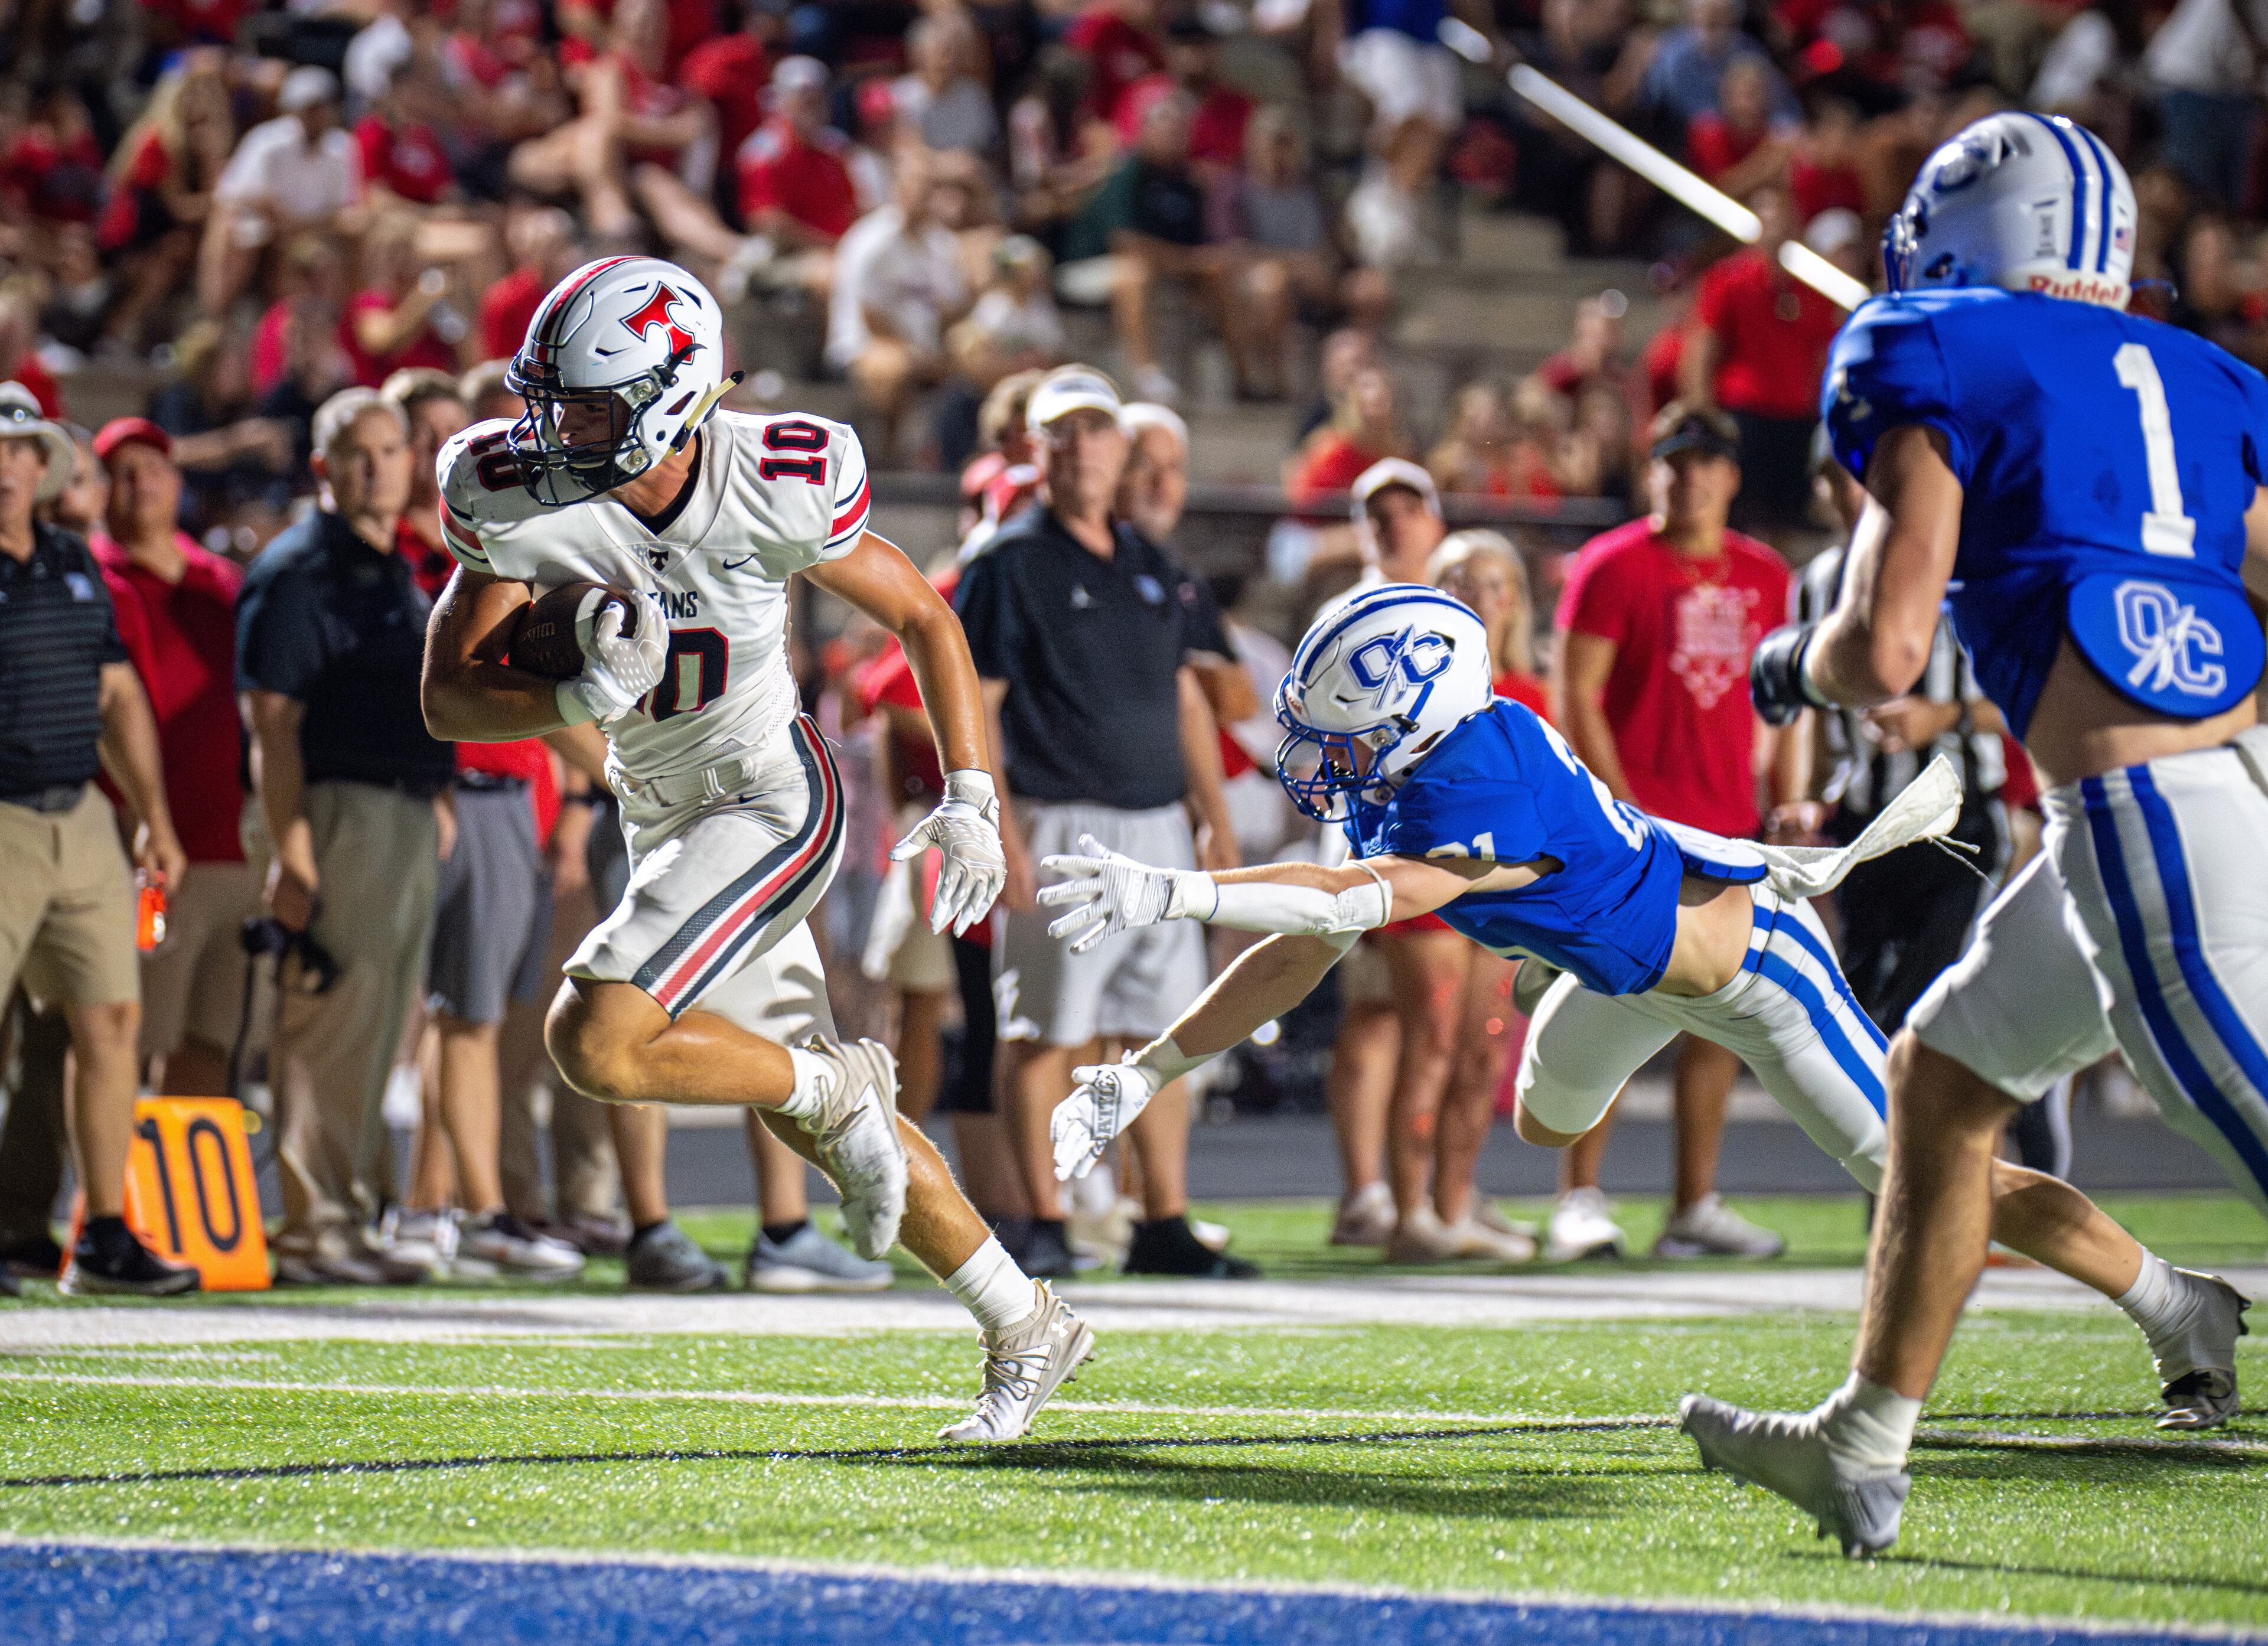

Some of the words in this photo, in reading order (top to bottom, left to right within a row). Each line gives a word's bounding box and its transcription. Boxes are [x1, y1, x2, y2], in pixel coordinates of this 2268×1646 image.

[760, 419, 830, 485] 10
[2113, 342, 2196, 558] 1
[634, 627, 729, 722] 0
[136, 1117, 242, 1253] 10
